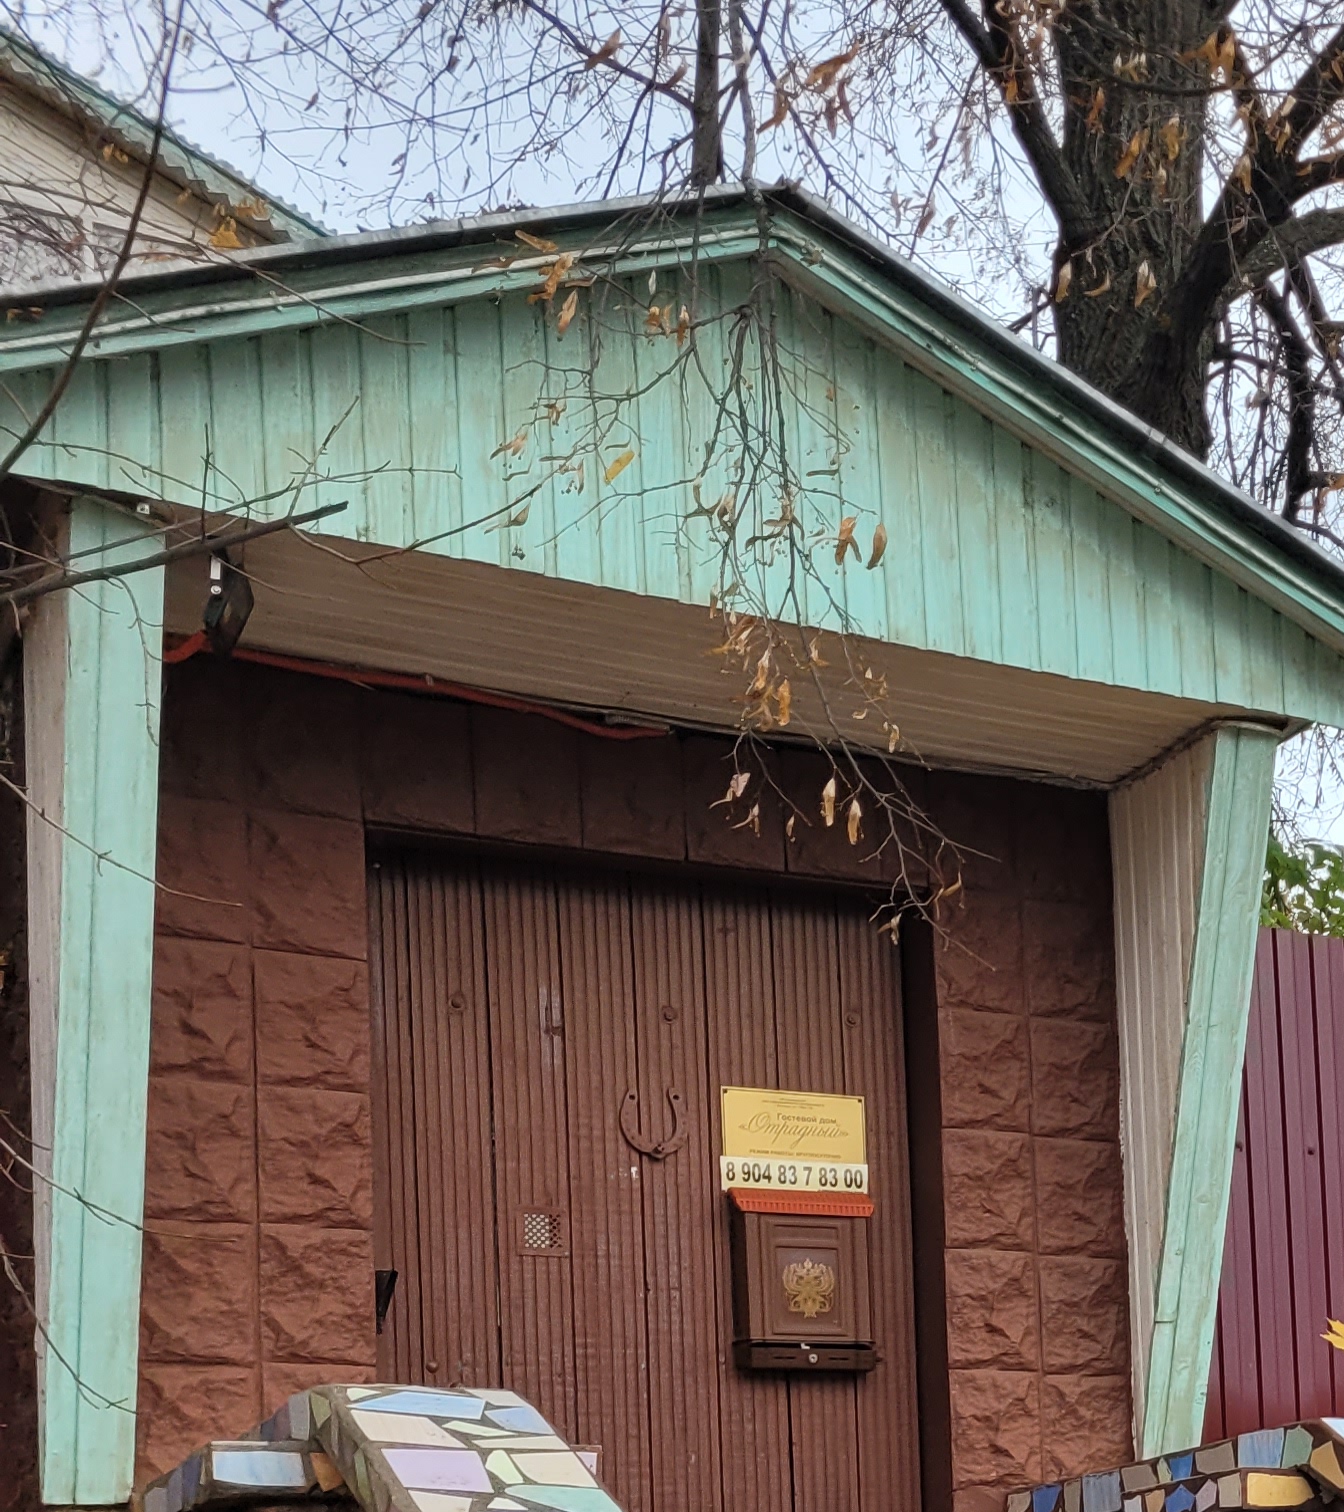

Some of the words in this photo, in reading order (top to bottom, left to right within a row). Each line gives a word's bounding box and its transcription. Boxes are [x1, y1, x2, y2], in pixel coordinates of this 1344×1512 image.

[777, 1113, 817, 1123] Гостевой
[819, 1117, 837, 1125] дом
[726, 1162, 735, 1181] 8
[742, 1163, 772, 1183] 904
[778, 1165, 797, 1185] 83
[803, 1166, 812, 1186] 7
[819, 1167, 838, 1187] 83
[844, 1169, 863, 1189] 00
